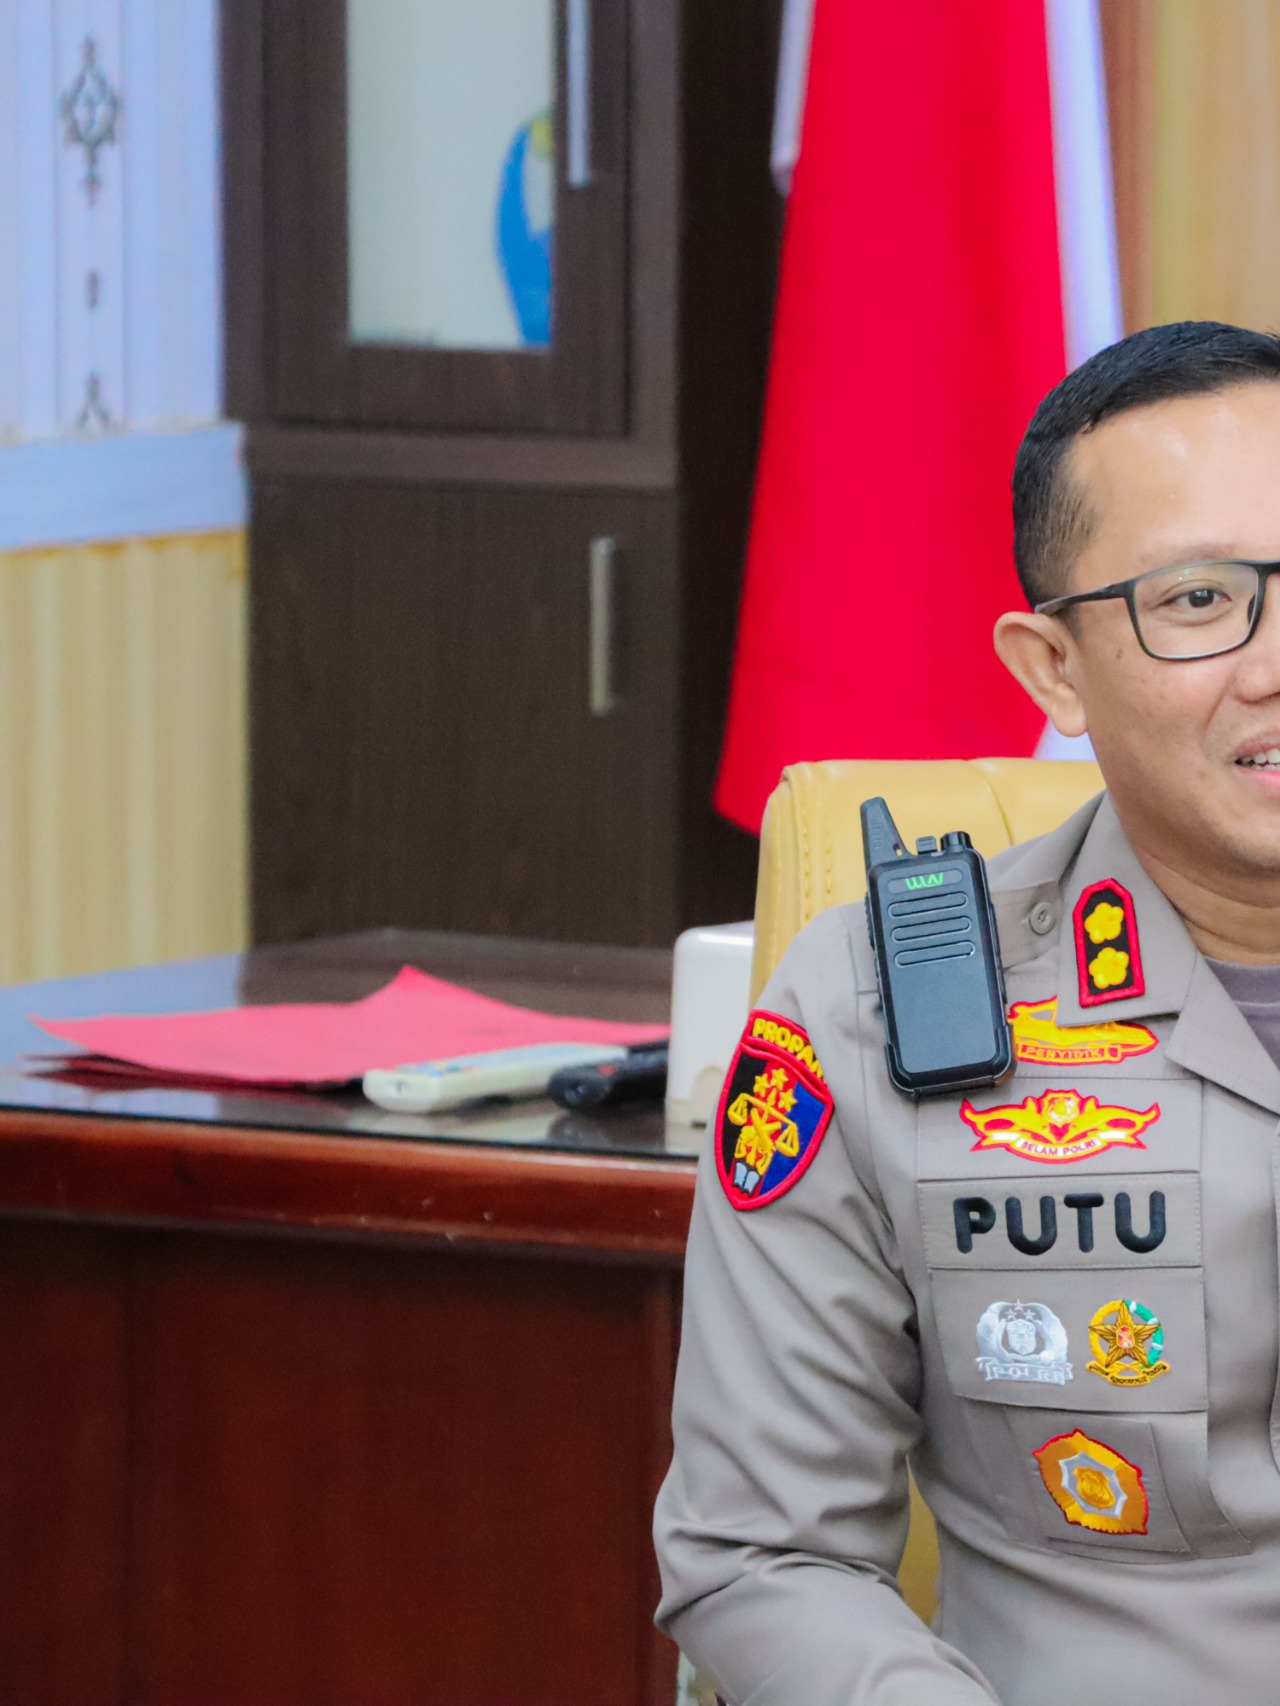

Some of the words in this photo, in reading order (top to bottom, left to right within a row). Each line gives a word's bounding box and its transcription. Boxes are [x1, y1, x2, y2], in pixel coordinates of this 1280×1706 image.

[1025, 1046, 1102, 1059] PENYIDIK
[1020, 1140, 1059, 1155] SELAM
[1062, 1139, 1097, 1154] POLRI
[953, 1190, 1167, 1256] PUTU
